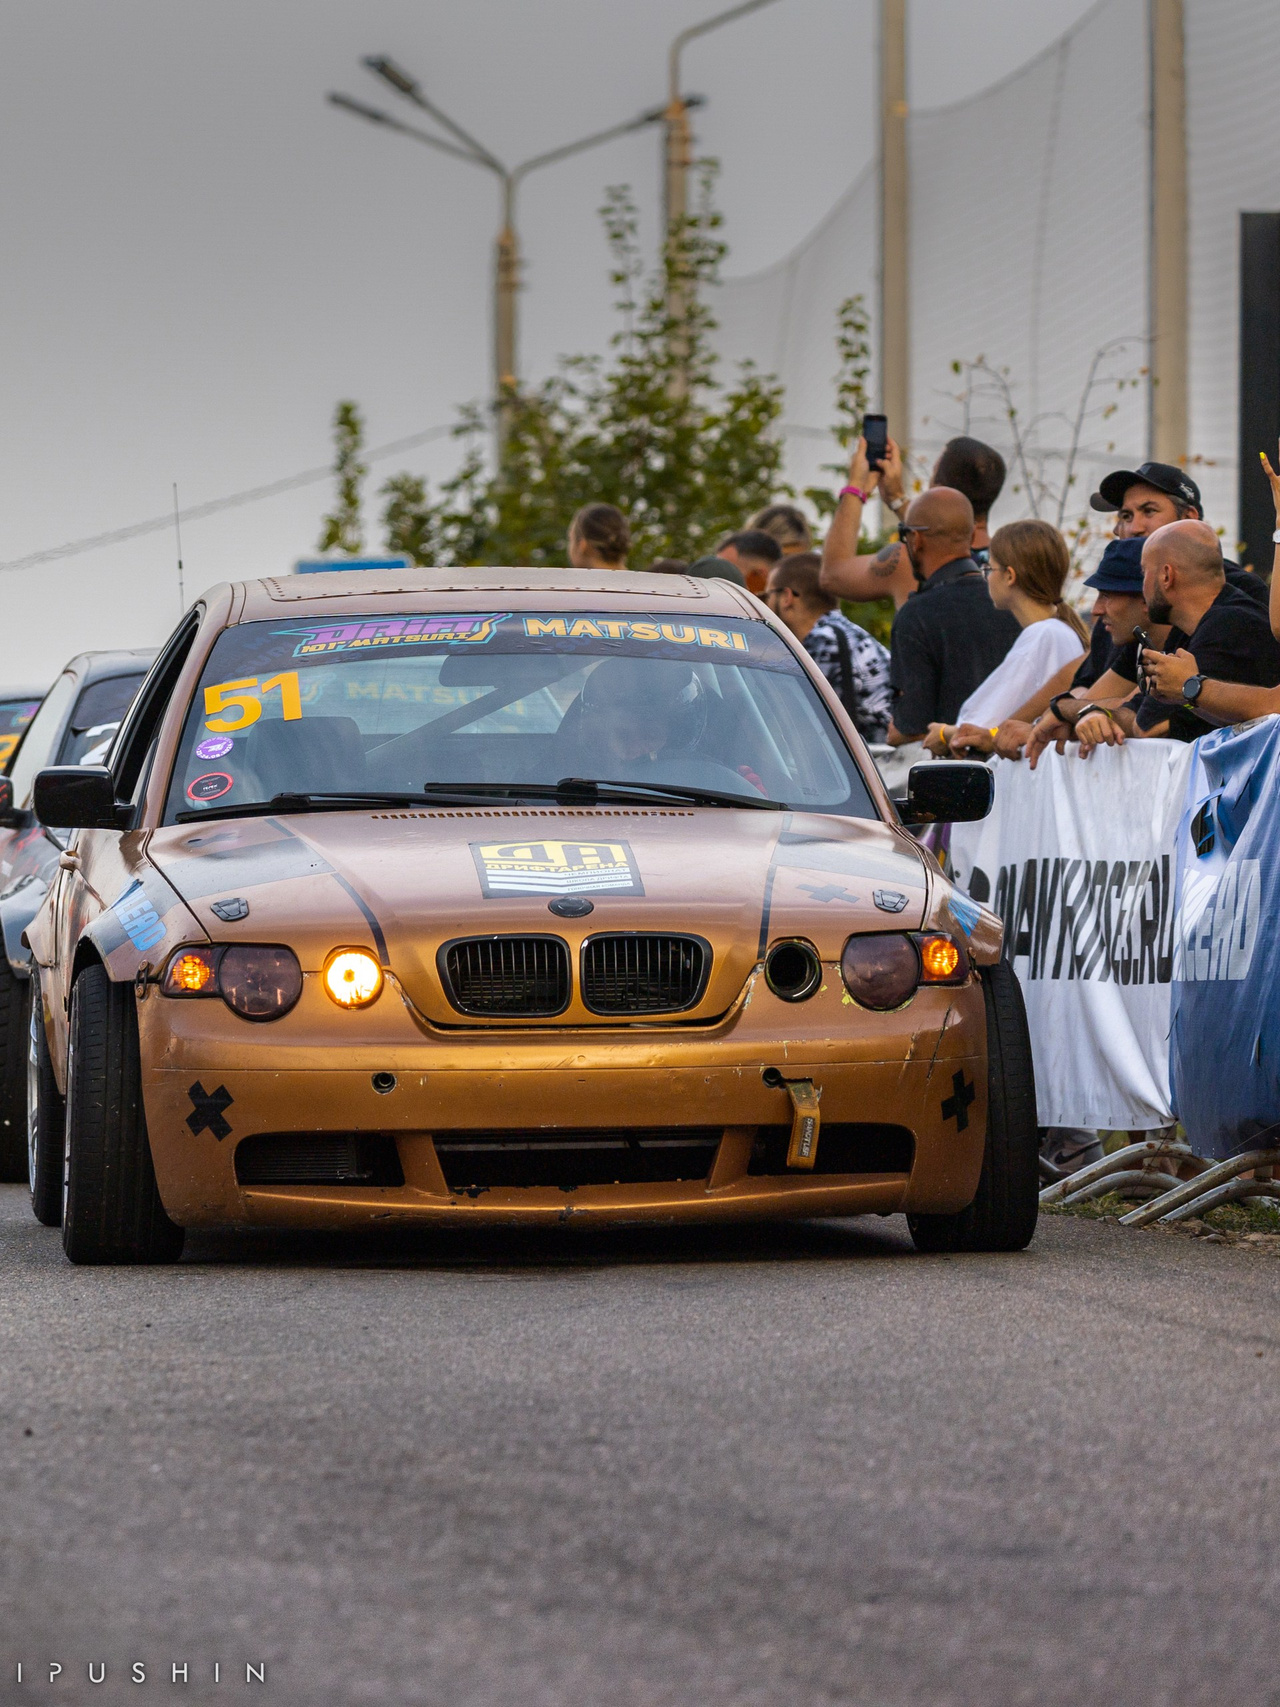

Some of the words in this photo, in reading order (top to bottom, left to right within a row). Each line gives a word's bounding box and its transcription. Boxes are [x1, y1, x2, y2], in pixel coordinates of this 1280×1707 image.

[348, 631, 472, 649] MATSURI
[523, 617, 750, 652] MATSURI
[203, 671, 303, 733] 51
[486, 862, 629, 873] ДРИФТАРЕНА
